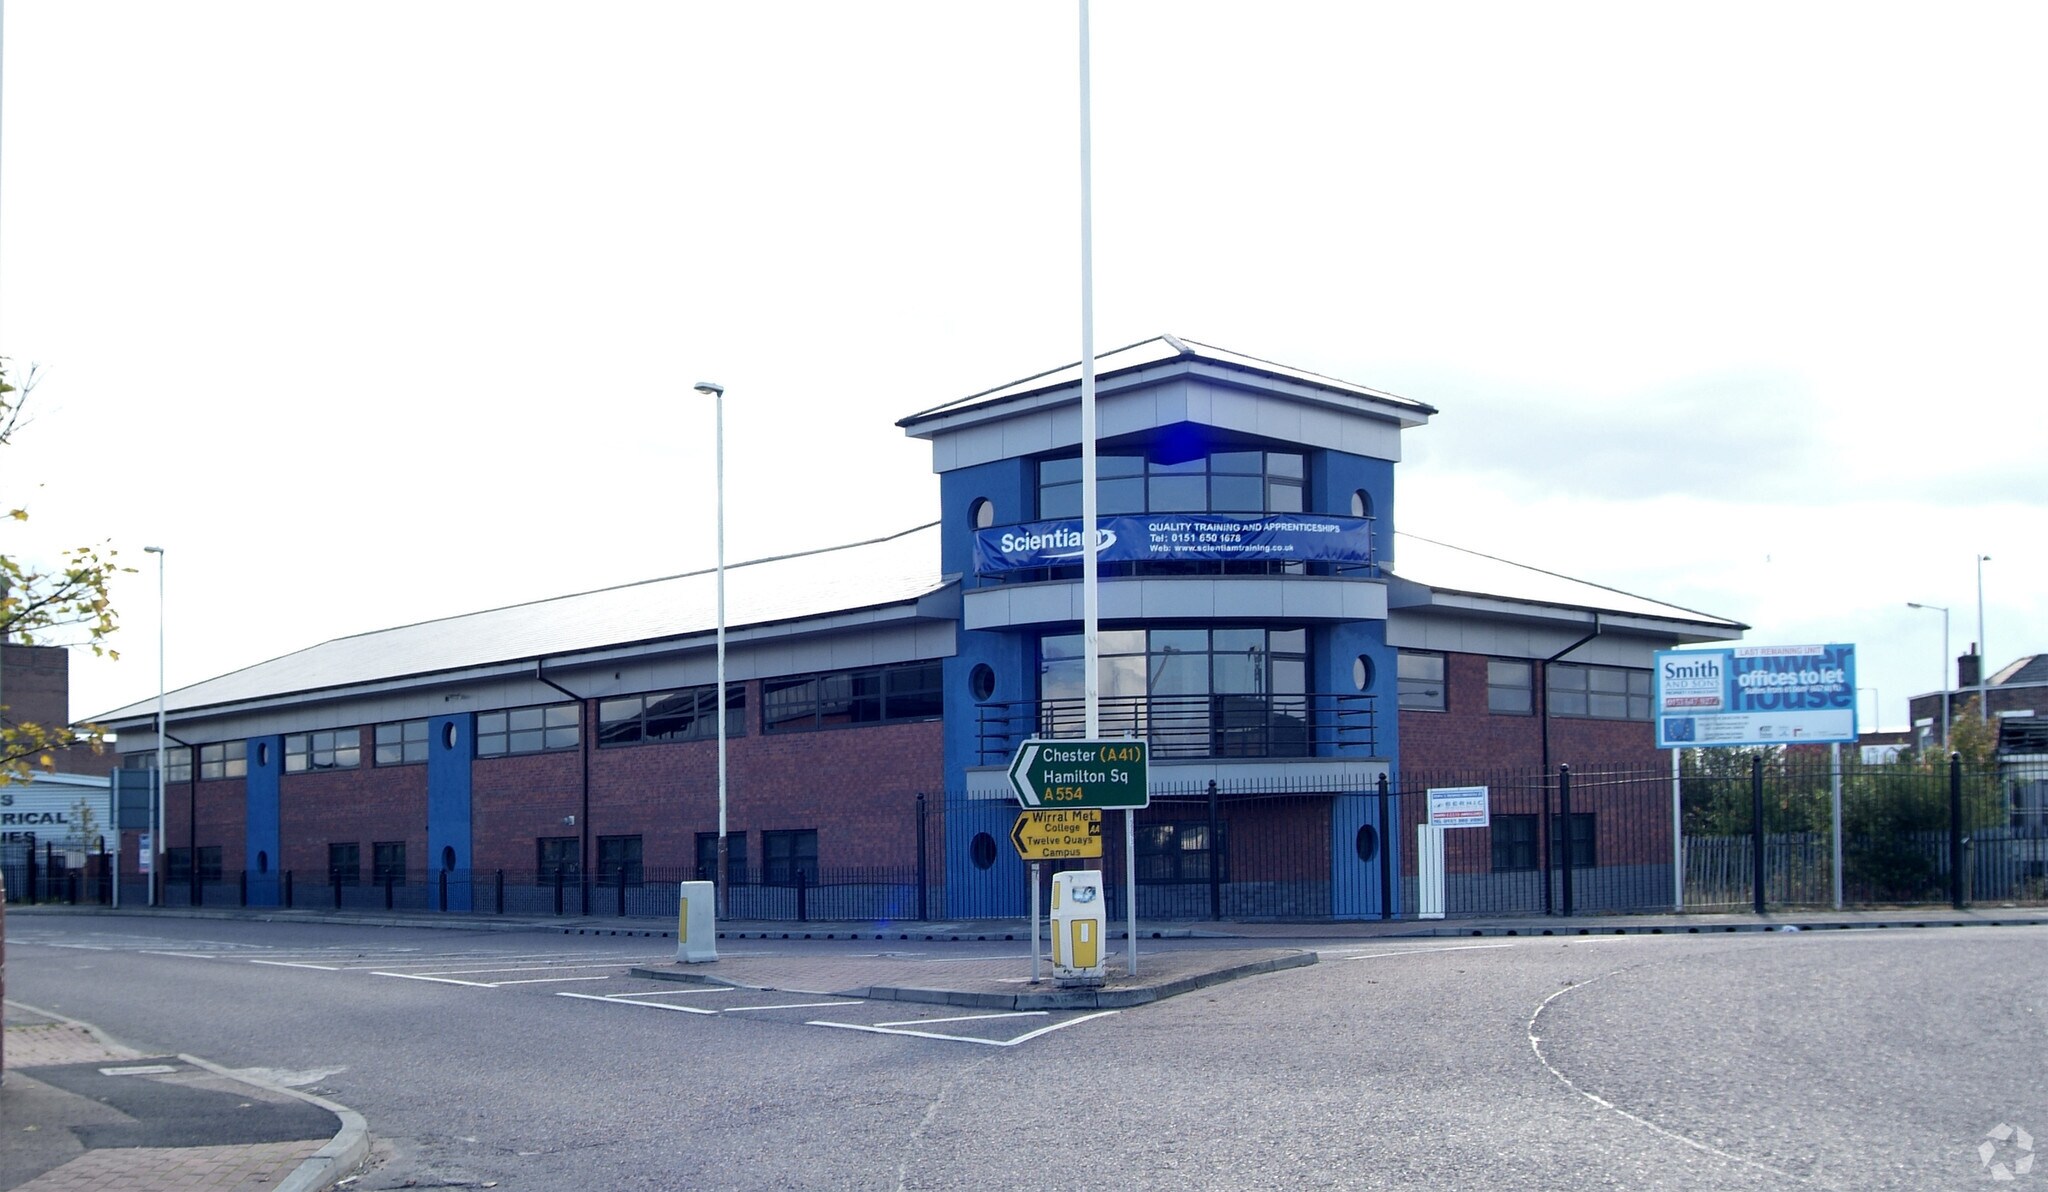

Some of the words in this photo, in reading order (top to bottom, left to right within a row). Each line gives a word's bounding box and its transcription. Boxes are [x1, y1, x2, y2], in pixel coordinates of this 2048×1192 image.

[1149, 523, 1191, 531] QUALITY
[1194, 523, 1240, 531] TRAINING
[1242, 523, 1262, 531] AND
[1263, 523, 1340, 533] APPRENTICESHIPS
[1150, 534, 1168, 542] Tel:
[1171, 534, 1195, 542] 0151
[1199, 534, 1217, 542] 650
[1220, 533, 1241, 542] 1678
[1150, 544, 1171, 552] Web:
[1174, 544, 1294, 553] www.scientiamtraining.co.uk
[1665, 660, 1719, 679] Smith
[1738, 670, 1799, 687] offices
[1799, 669, 1819, 684] to
[1820, 668, 1845, 683] let
[1043, 748, 1096, 762] Chester
[1044, 770, 1105, 783] Hamilton
[1110, 769, 1128, 784] Sq
[1032, 811, 1067, 822] Wirral
[1072, 811, 1097, 821] Met.
[1044, 824, 1080, 833] College
[1027, 836, 1060, 845] Twelve
[1063, 836, 1093, 846] Quays
[1042, 848, 1081, 858] Campus
